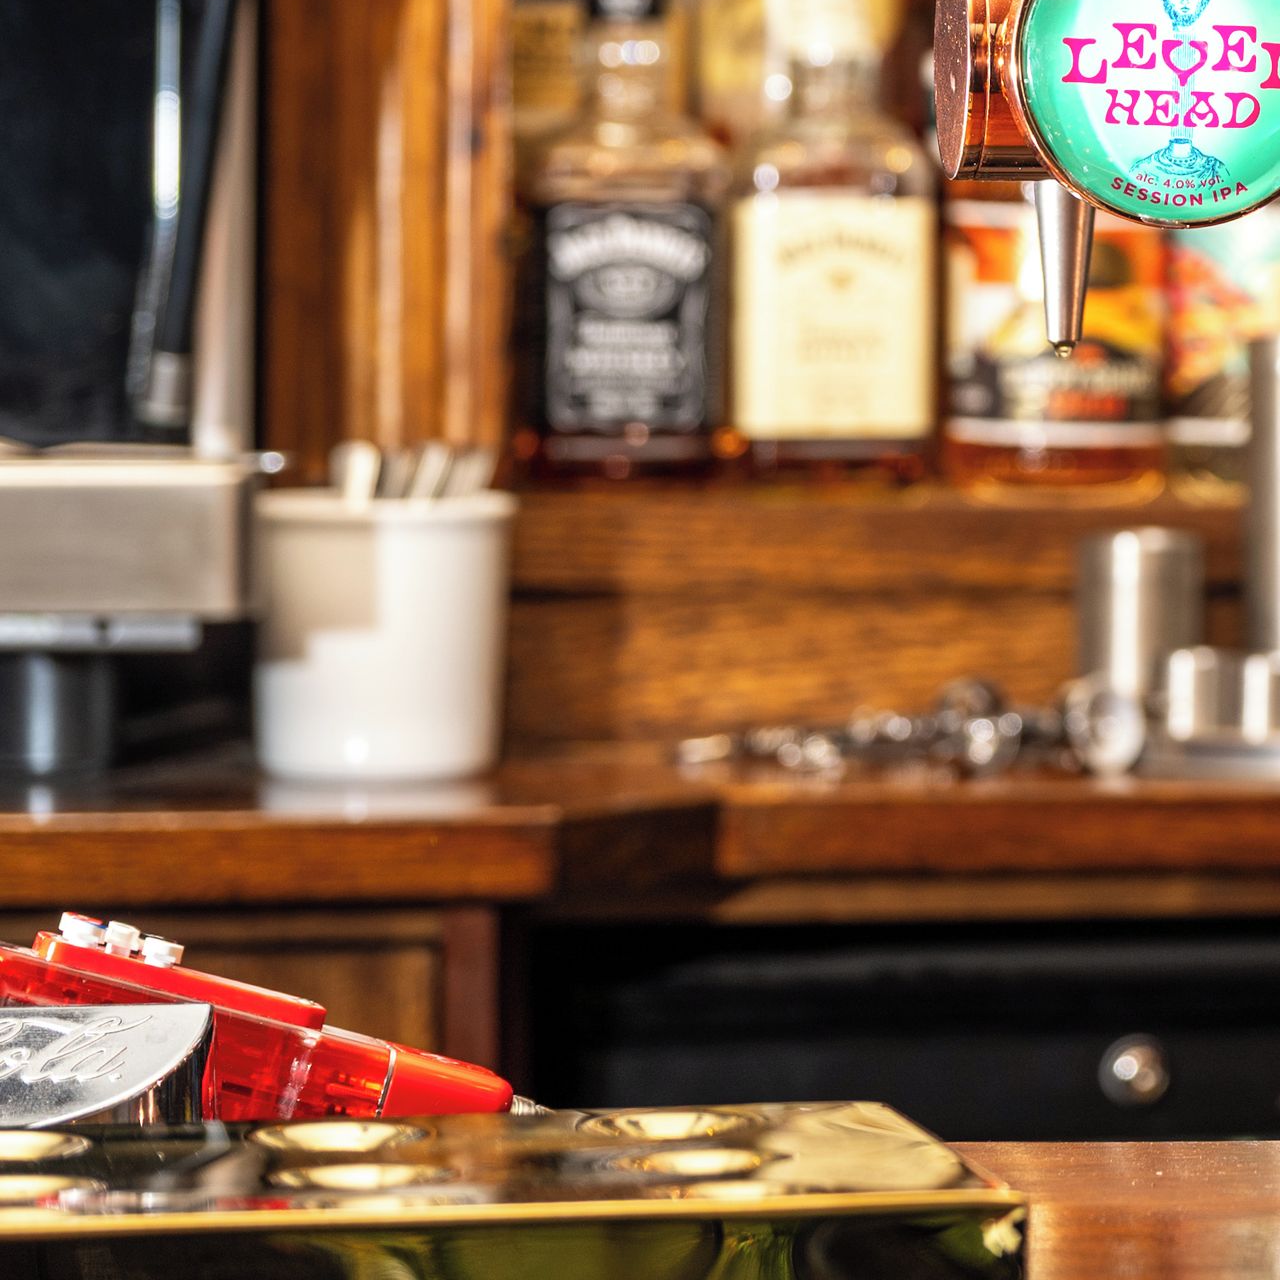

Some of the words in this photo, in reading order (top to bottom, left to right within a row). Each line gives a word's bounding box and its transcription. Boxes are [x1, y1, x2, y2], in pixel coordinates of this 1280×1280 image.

[1104, 89, 1261, 128] HEAD
[1110, 177, 1203, 206] SESSION
[1213, 181, 1248, 203] IPA
[1135, 172, 1158, 187] alc.
[1163, 177, 1196, 190] 4.0%
[1200, 175, 1225, 189] vol.
